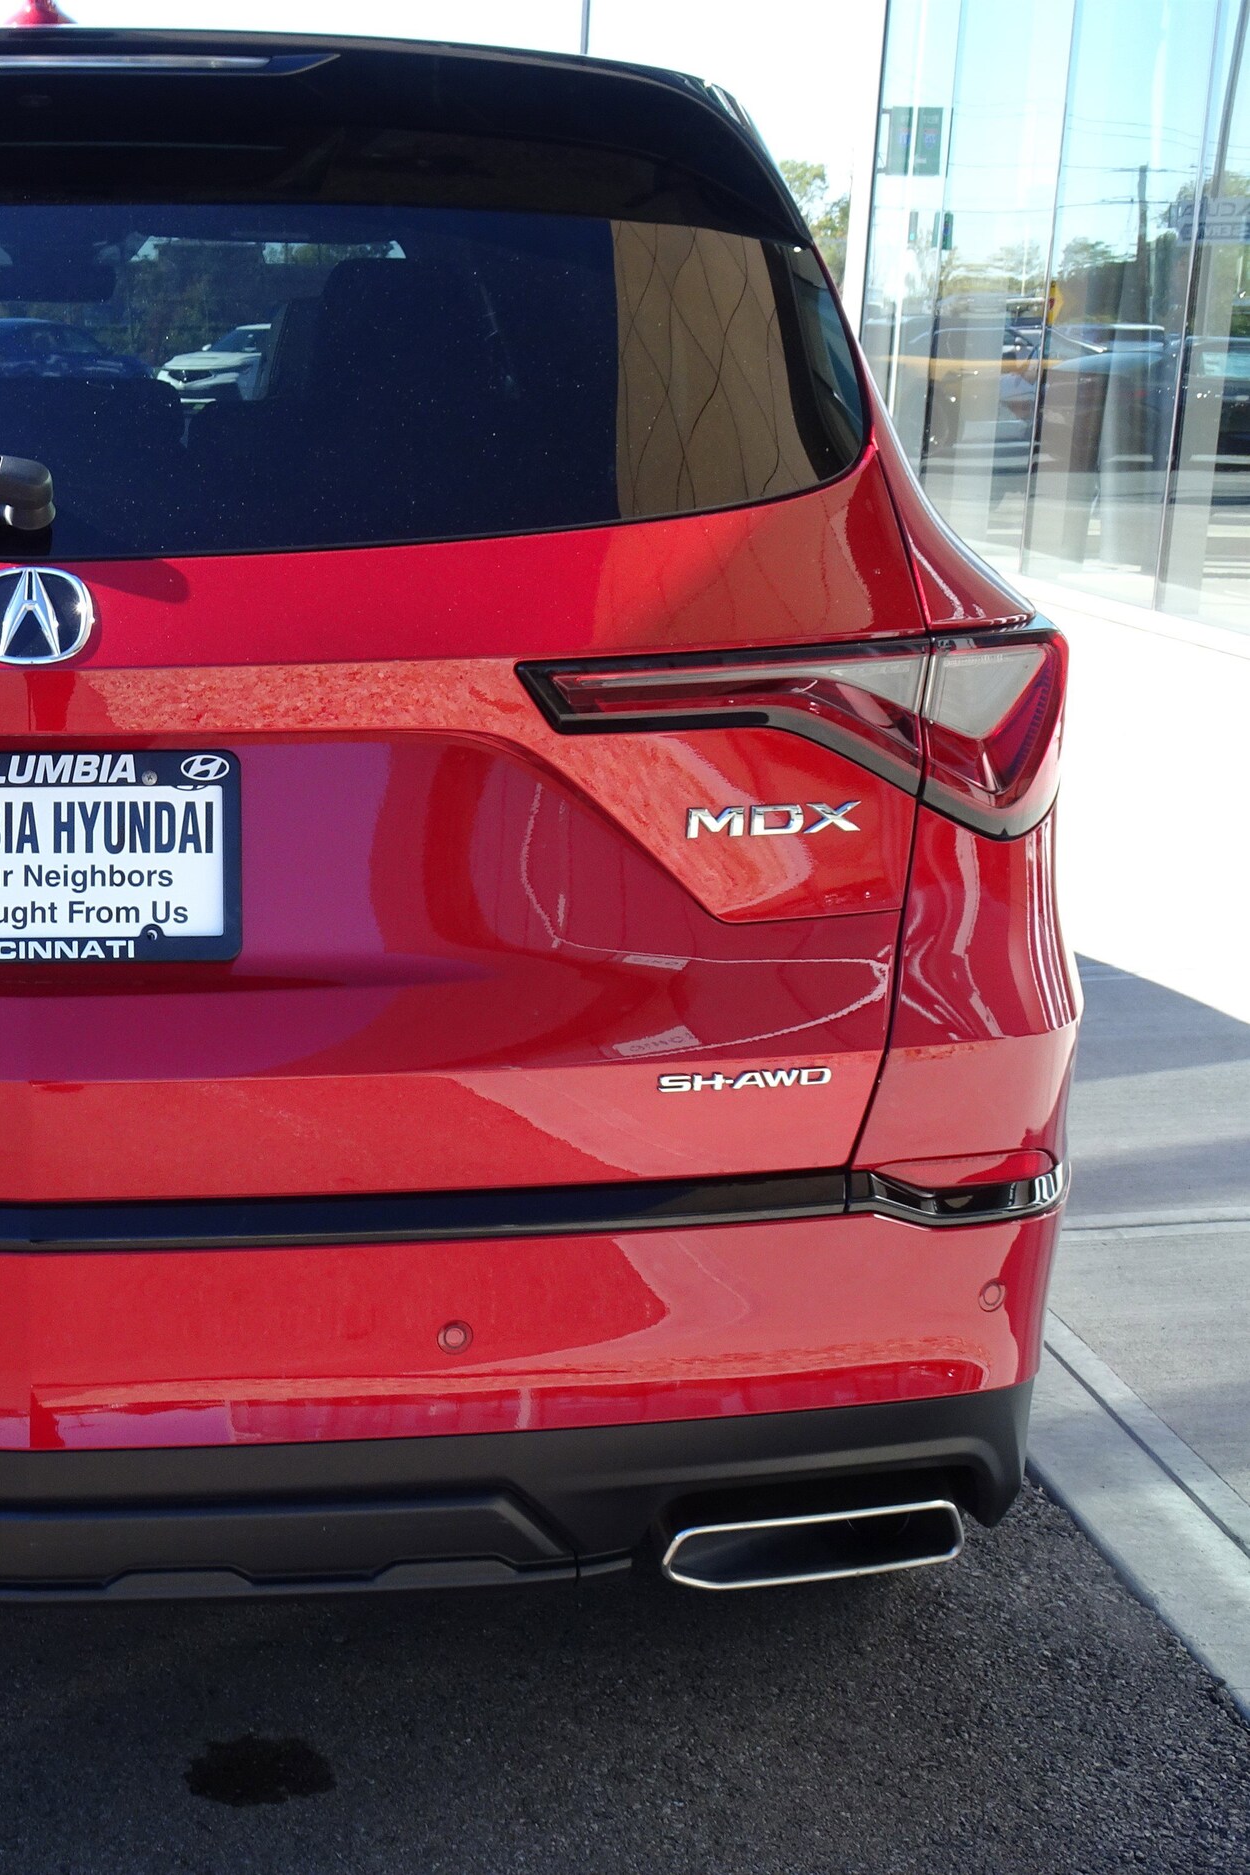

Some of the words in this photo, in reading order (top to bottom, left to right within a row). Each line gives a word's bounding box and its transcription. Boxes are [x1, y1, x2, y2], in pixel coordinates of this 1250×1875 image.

[53, 801, 214, 854] HYUNDAI
[686, 801, 861, 838] MDX
[23, 864, 174, 893] Neighbors
[68, 900, 141, 924] From
[151, 900, 189, 924] Us
[658, 1067, 832, 1092] SH-AWD
